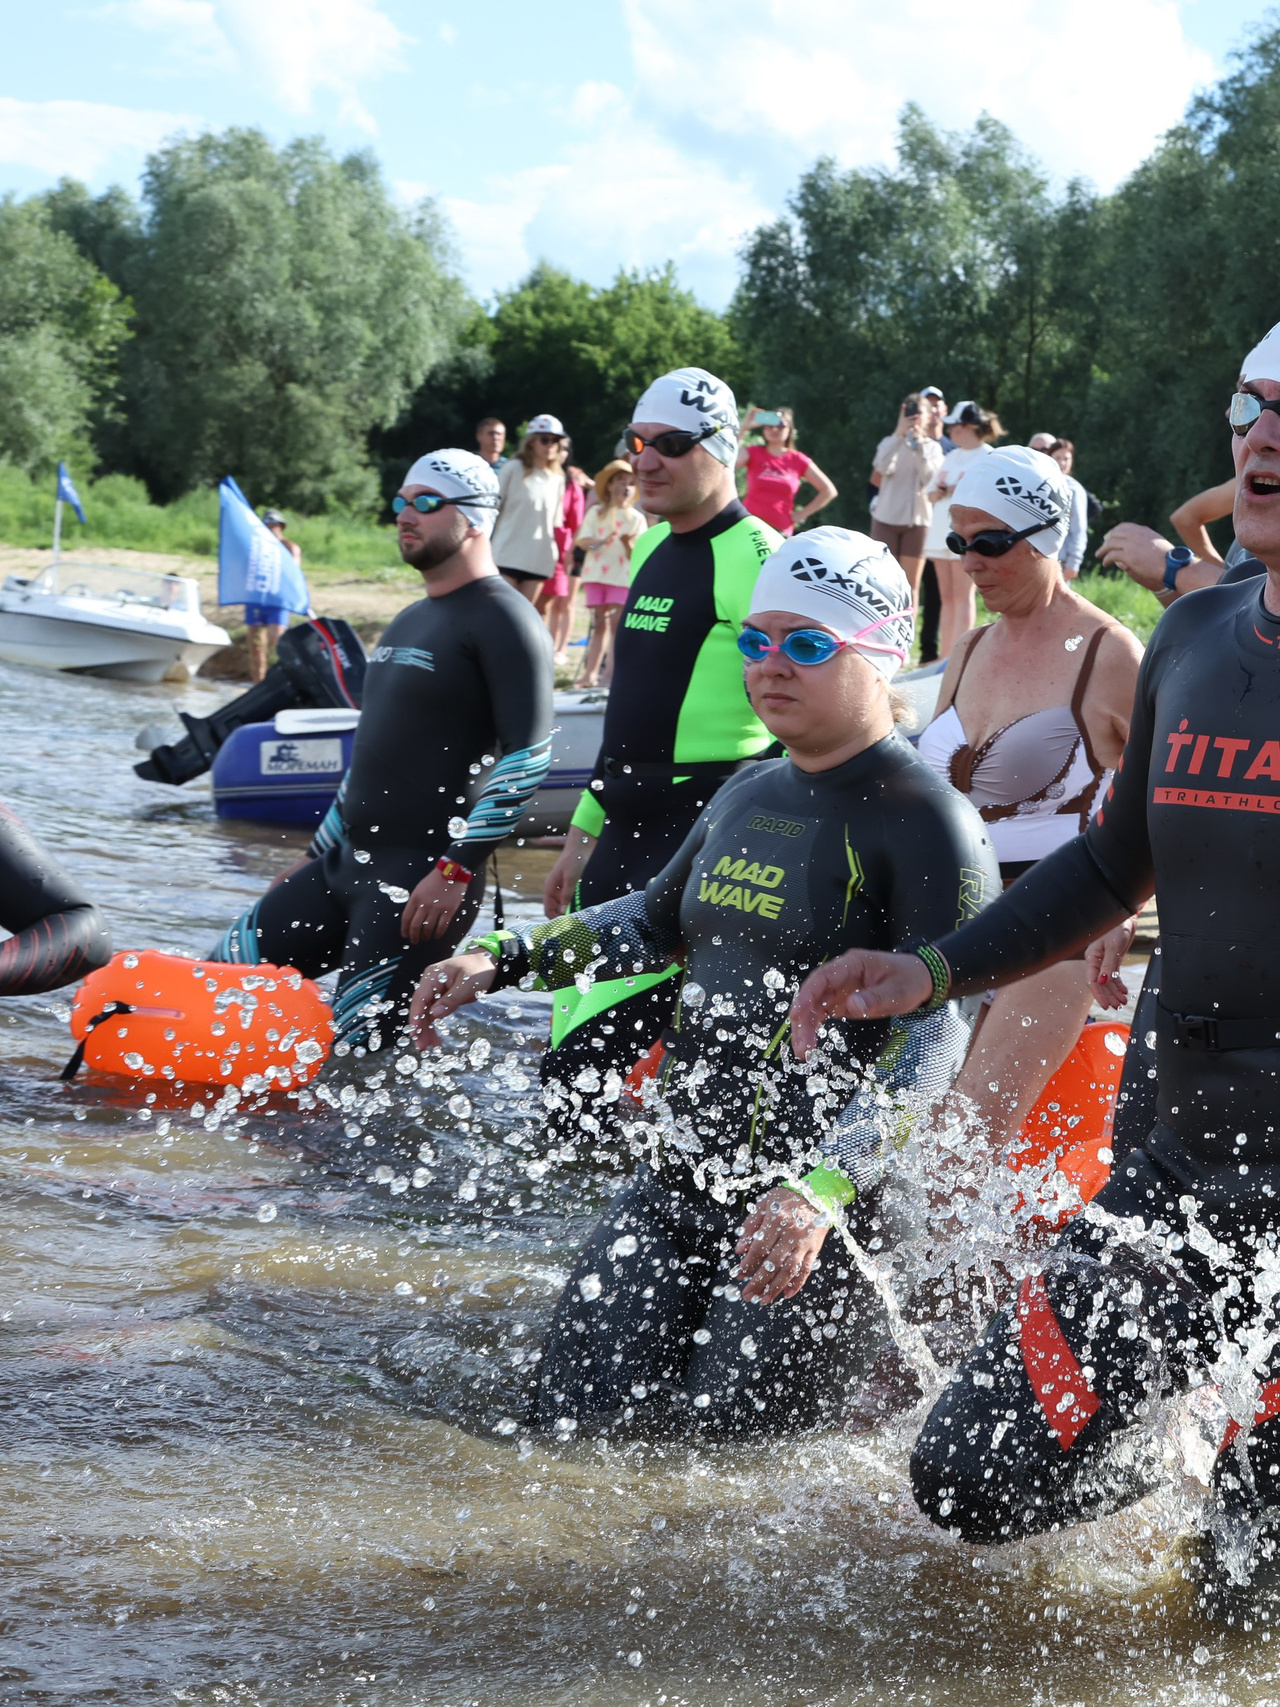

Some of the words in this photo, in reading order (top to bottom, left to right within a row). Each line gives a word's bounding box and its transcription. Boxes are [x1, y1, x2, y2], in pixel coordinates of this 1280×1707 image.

[633, 595, 675, 613] MAD
[624, 612, 672, 633] WAVE
[746, 815, 806, 838] RAPID
[711, 855, 786, 889] MAD
[699, 879, 786, 921] WAVE
